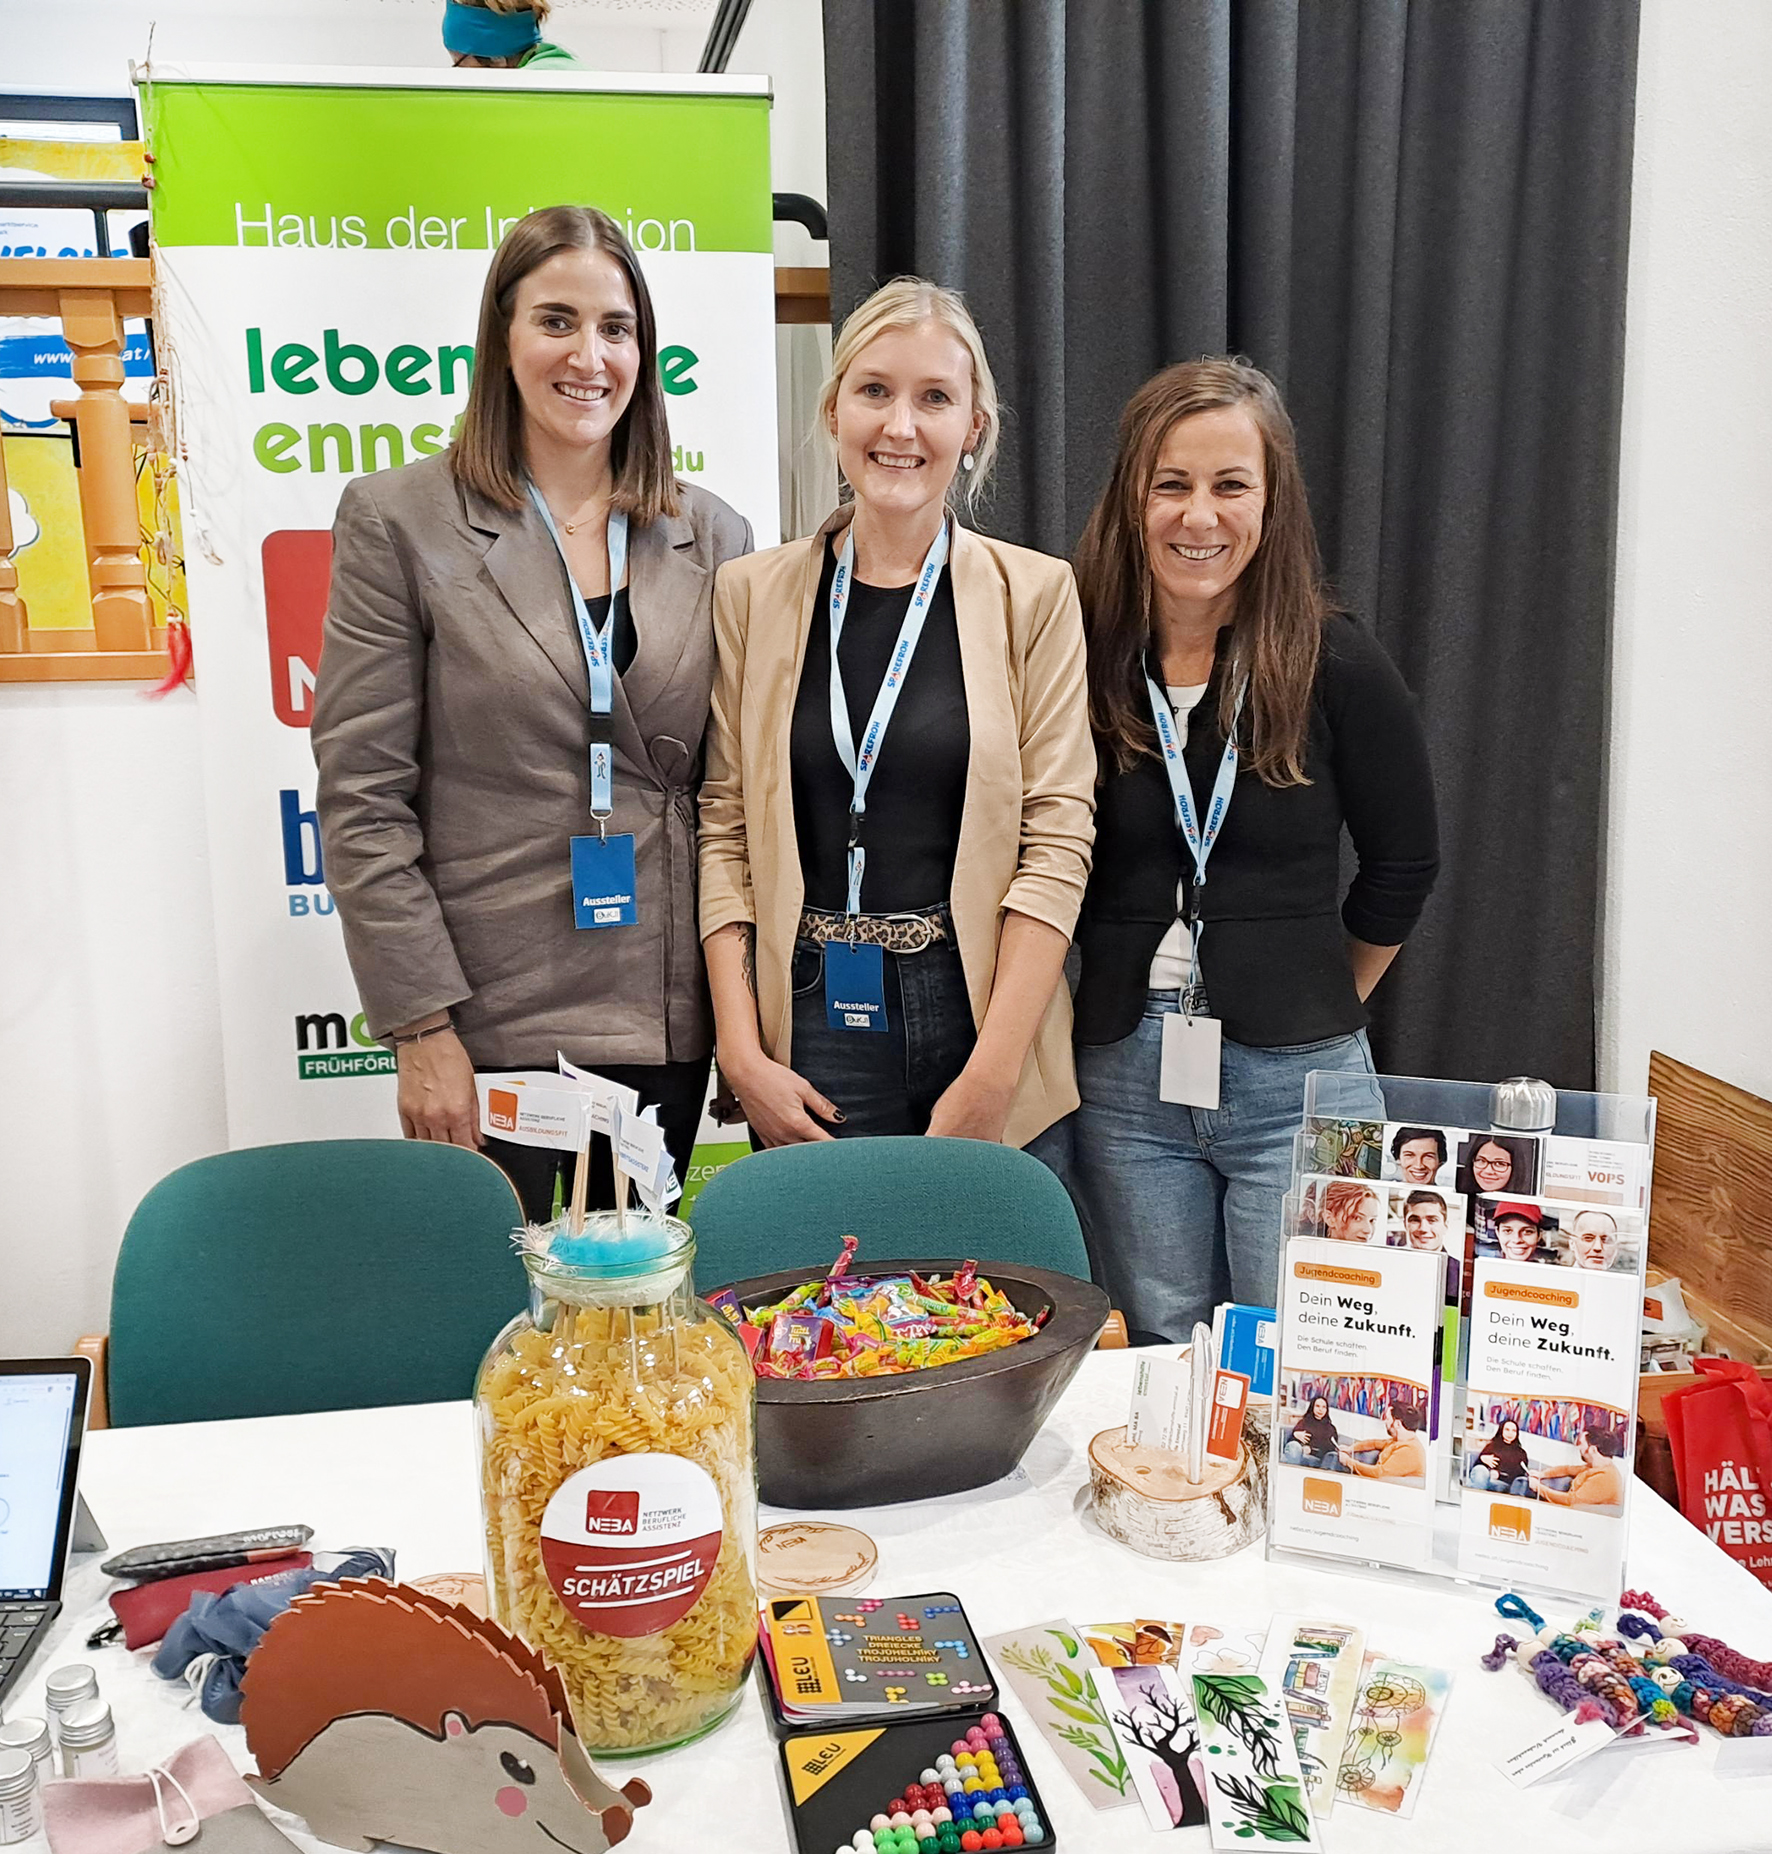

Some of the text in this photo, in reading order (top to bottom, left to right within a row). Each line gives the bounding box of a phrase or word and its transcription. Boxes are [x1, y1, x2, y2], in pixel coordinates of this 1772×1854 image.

[235, 202, 696, 251] Haus der Inion
[246, 327, 700, 396] lebene
[253, 412, 465, 473] enns
[914, 562, 935, 607] SPAREFROH
[887, 639, 909, 688] SPAREFROH
[1157, 711, 1177, 760] SPAREFROH
[860, 721, 881, 771] SPAREFROH
[1204, 796, 1224, 847] SPAREFROH
[582, 894, 631, 907] Aussteller
[833, 1000, 880, 1012] Aussteller
[489, 1112, 514, 1130] NEBA
[1299, 1265, 1375, 1285] Jugendcoaching
[1299, 1291, 1378, 1316] Dein Weg,
[1490, 1285, 1572, 1305] Jugendcoaching
[1298, 1311, 1416, 1339] deine Zukunft.
[1489, 1311, 1575, 1337] Dein Weg,
[1296, 1343, 1311, 1351] Den
[1313, 1345, 1333, 1354] Beruf
[1297, 1334, 1309, 1342] Die
[1311, 1336, 1334, 1346] Schule
[1487, 1332, 1615, 1361] deine Zukunft.
[1486, 1356, 1499, 1364] Die
[1501, 1358, 1526, 1368] Schule
[1486, 1365, 1501, 1373] Den
[1503, 1367, 1524, 1376] Beruf
[1704, 1460, 1760, 1495] HÄL
[642, 1507, 682, 1518] NETZWERK
[1304, 1499, 1339, 1515] NEBA
[1704, 1493, 1766, 1519] WAS
[588, 1516, 634, 1533] NEBA
[642, 1512, 687, 1525] BERUFLICHE
[642, 1520, 682, 1531] ASSISTENZ
[1490, 1524, 1528, 1541] NEBA
[1706, 1519, 1772, 1545] VERS
[562, 1558, 705, 1597] SCHÄTZSPIEL
[862, 1634, 924, 1643] TRIANGLES
[868, 1641, 923, 1649] DREIECKE
